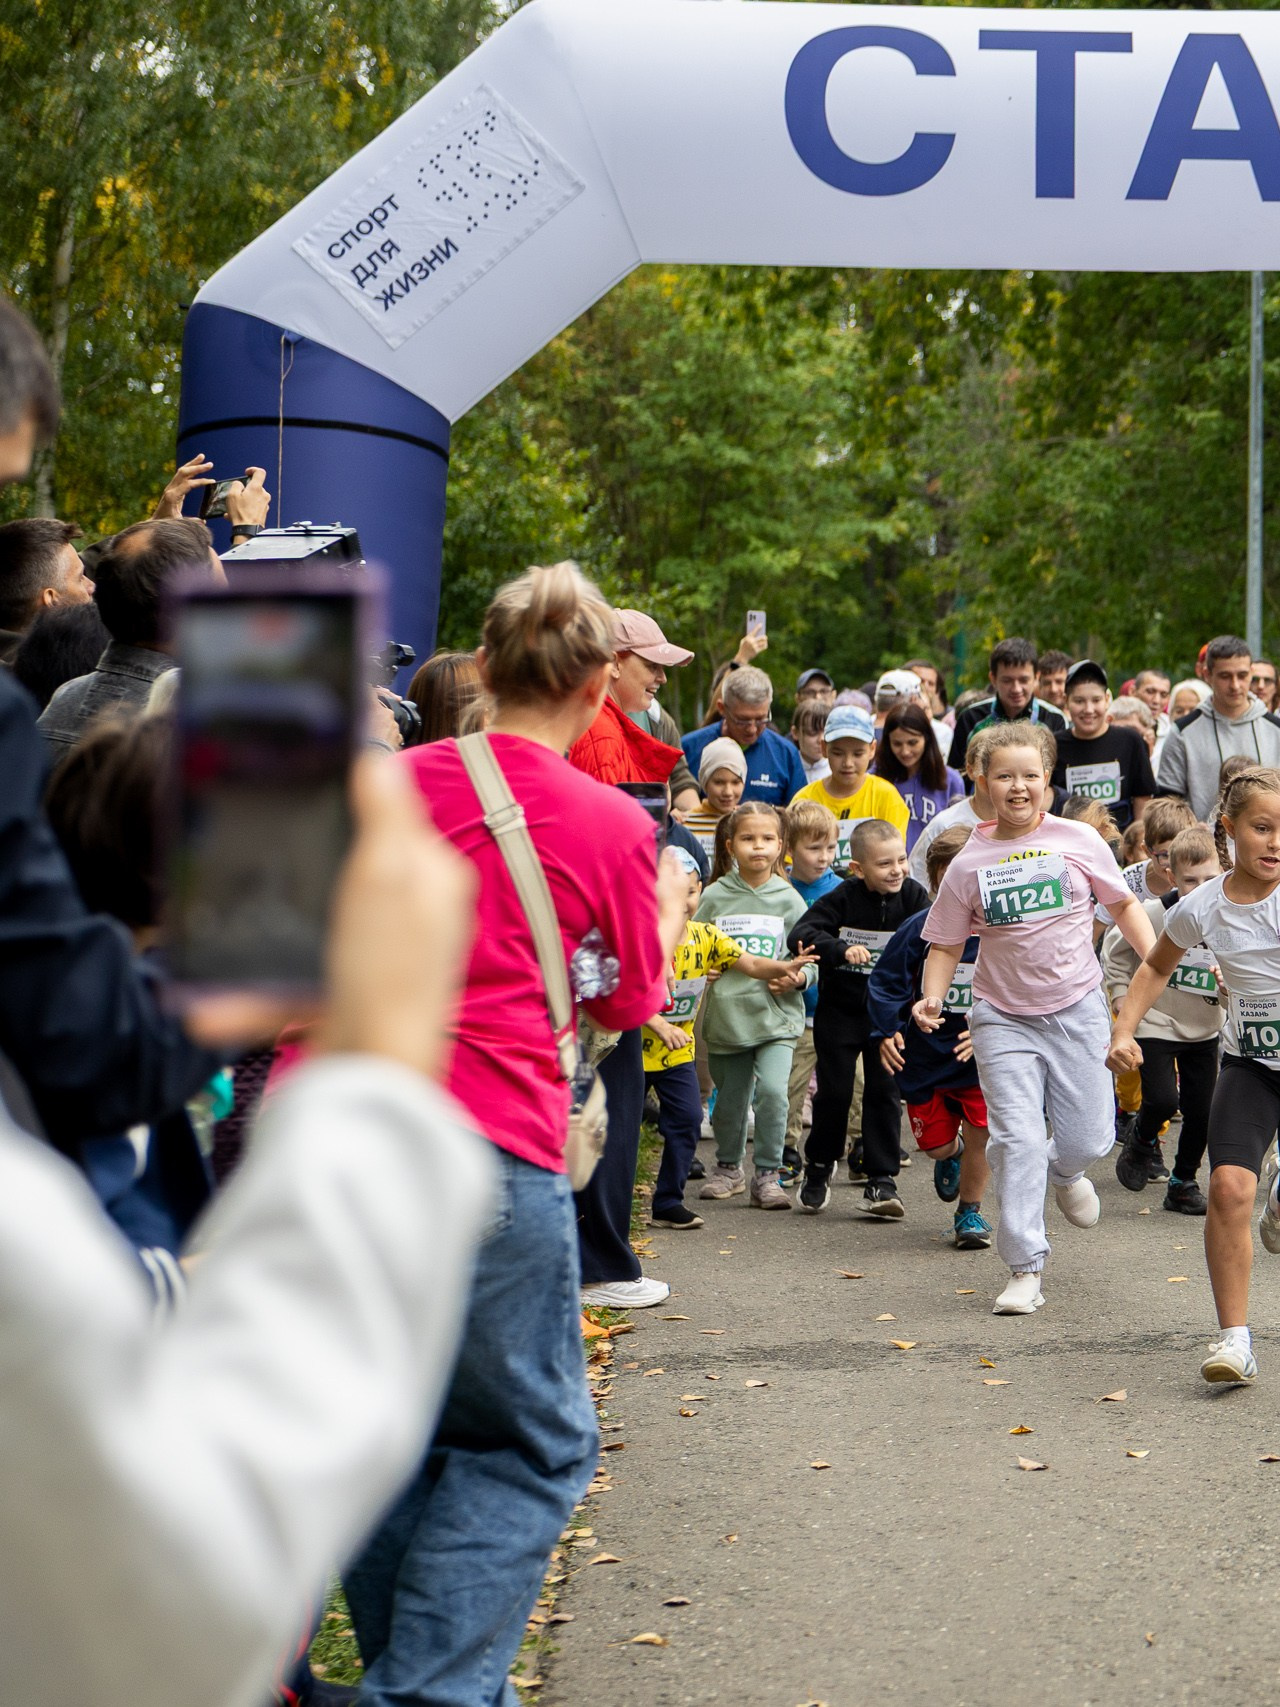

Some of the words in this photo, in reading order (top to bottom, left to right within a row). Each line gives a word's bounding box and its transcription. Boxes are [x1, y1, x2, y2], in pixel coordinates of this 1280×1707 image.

[1074, 783, 1113, 798] 1100
[904, 793, 936, 824] AP
[987, 878, 1016, 886] КАЗАНЬ
[995, 885, 1056, 914] 1124
[736, 937, 774, 956] 033
[1174, 968, 1209, 987] 141
